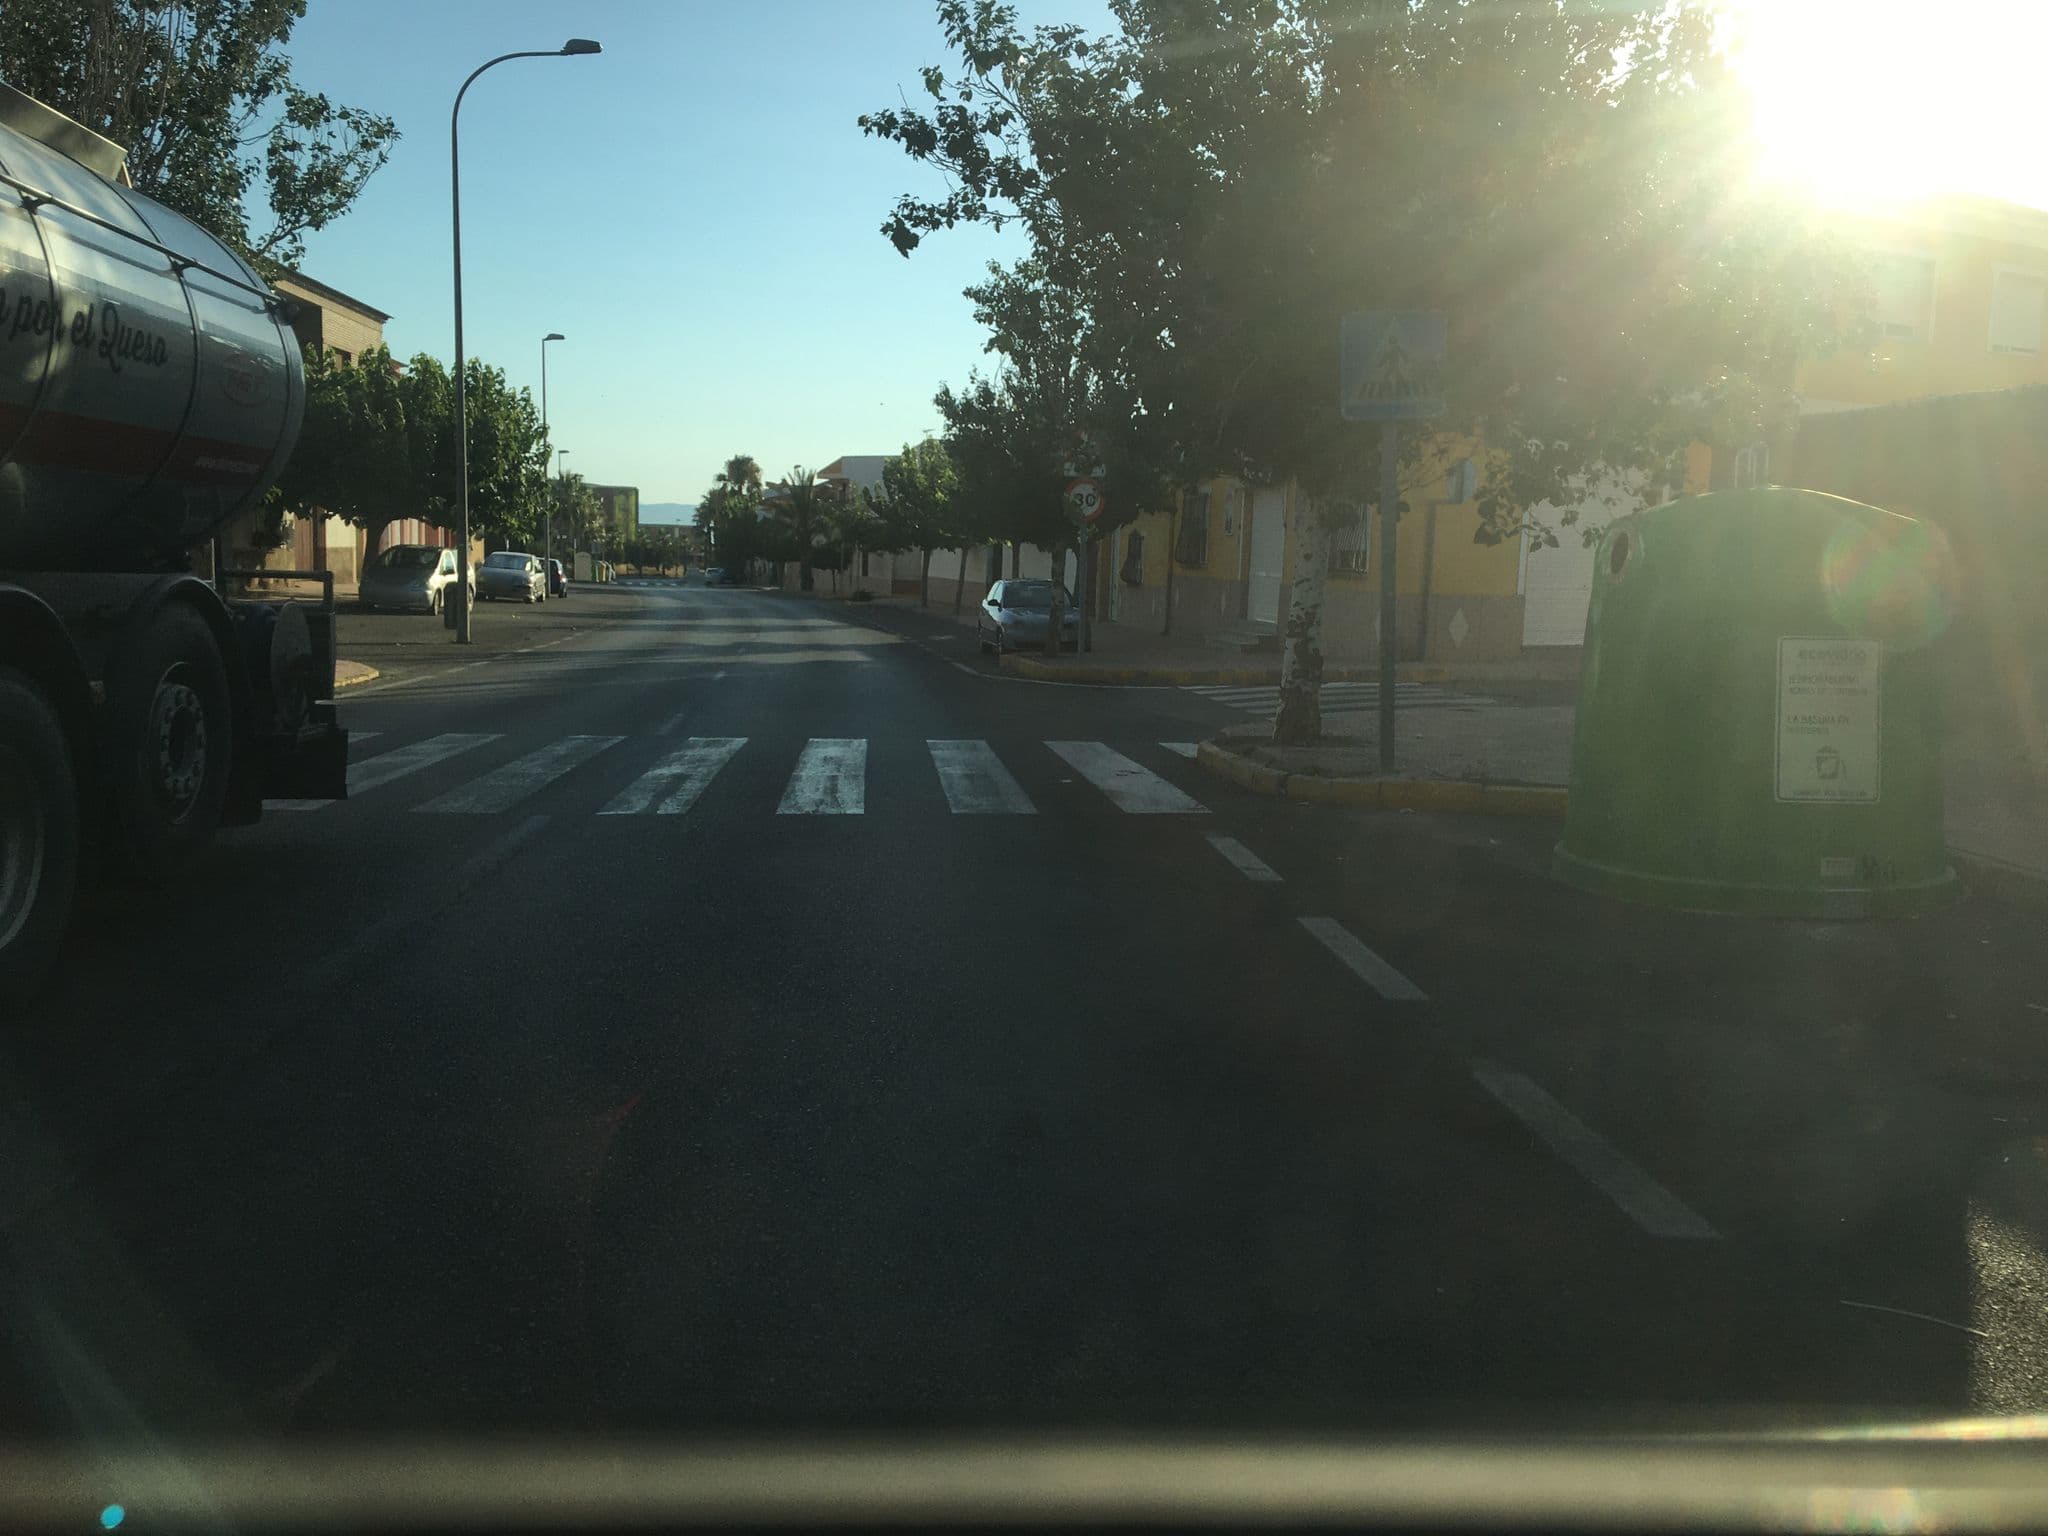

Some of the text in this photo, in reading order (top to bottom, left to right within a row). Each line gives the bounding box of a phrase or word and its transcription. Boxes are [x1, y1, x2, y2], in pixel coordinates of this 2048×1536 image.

[8, 294, 66, 342] por
[71, 302, 95, 347] el
[98, 301, 169, 373] Queso
[1073, 493, 1096, 507] 30
